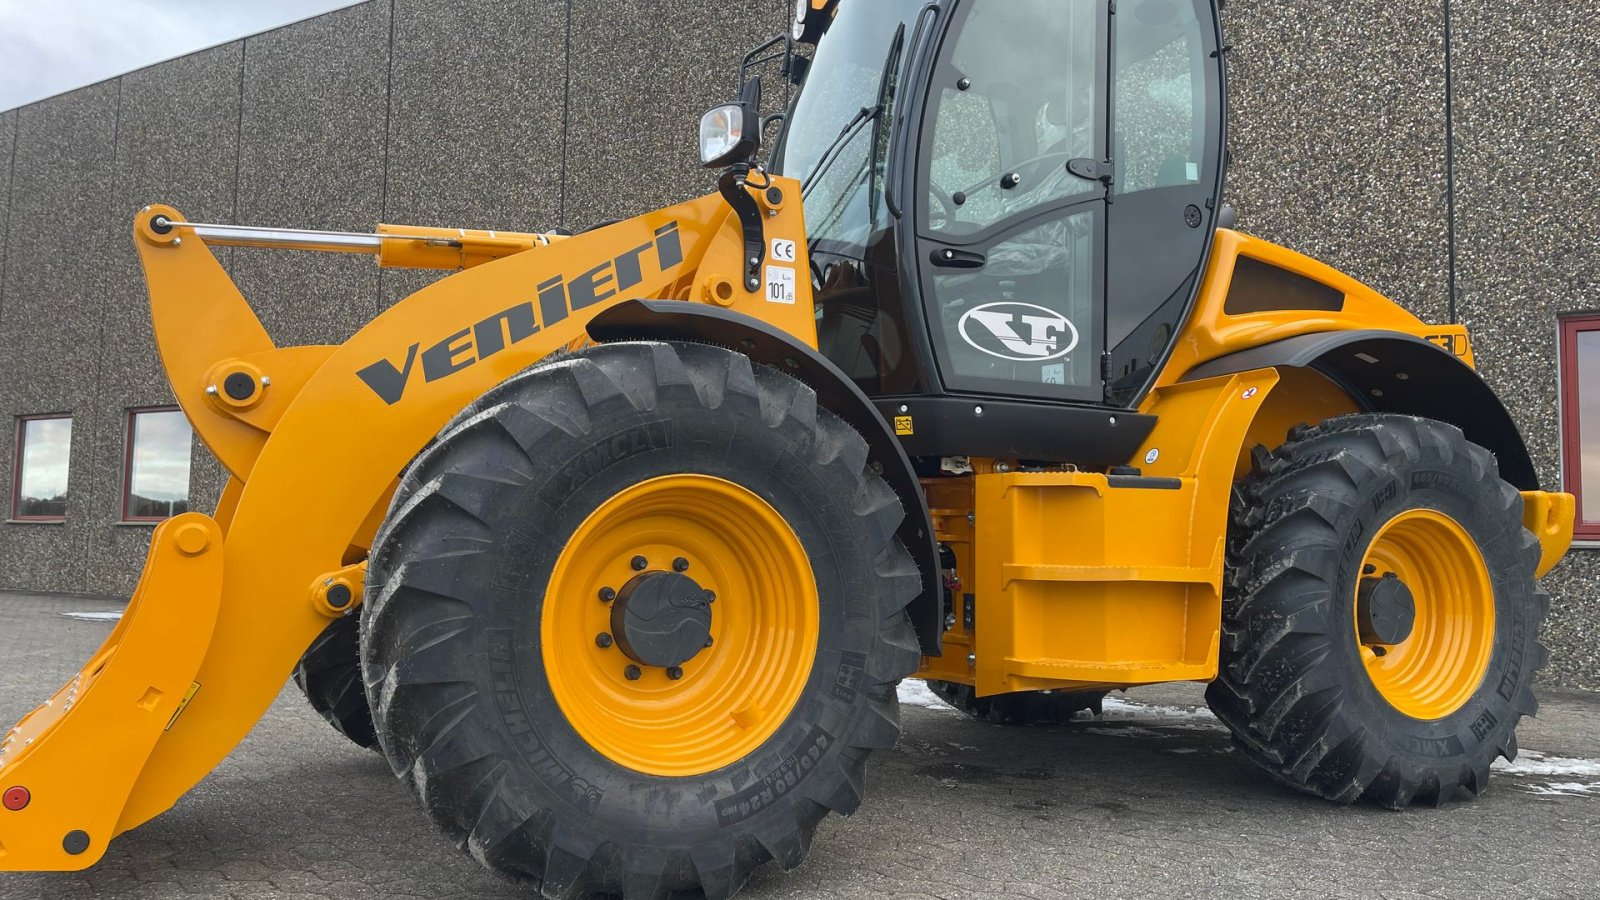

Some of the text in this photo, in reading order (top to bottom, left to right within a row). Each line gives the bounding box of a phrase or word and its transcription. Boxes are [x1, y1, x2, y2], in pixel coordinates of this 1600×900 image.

[775, 243, 792, 258] CE
[768, 282, 785, 300] 101
[740, 787, 774, 816] R24
